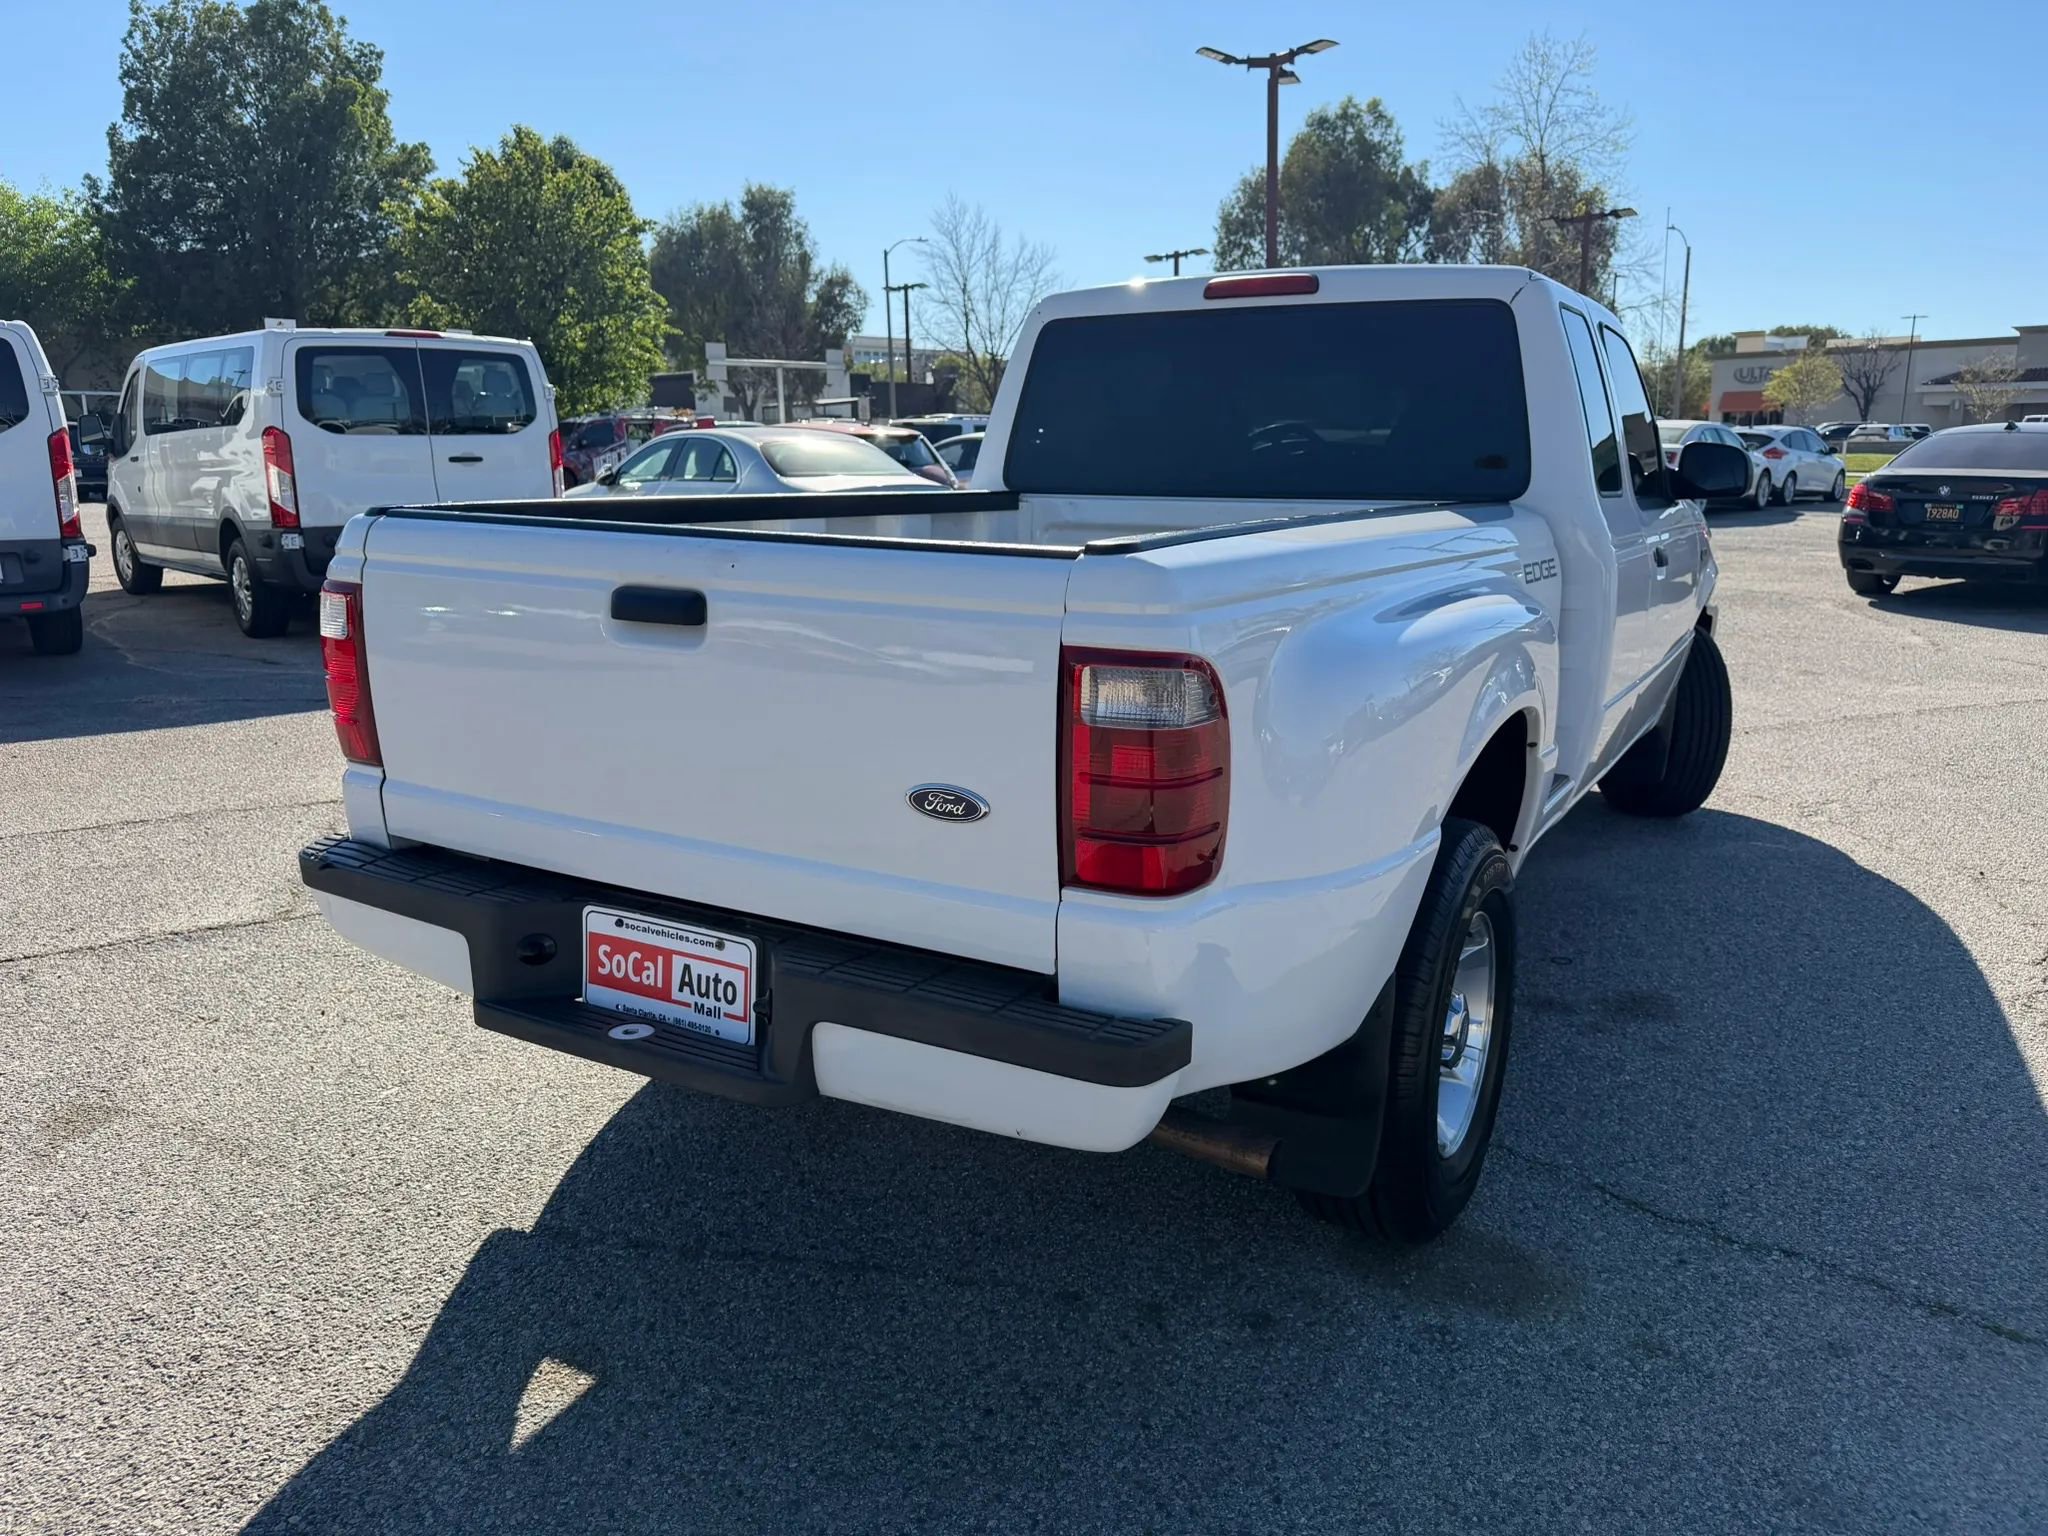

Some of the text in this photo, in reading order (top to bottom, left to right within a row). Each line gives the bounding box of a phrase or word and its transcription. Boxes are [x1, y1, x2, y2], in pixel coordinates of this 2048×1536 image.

[1523, 558, 1557, 584] EDGE
[924, 792, 966, 815] Ford
[624, 922, 715, 949] socalvehicles.com
[598, 944, 664, 988] SoCal
[678, 963, 737, 1006] Auto
[694, 1001, 721, 1020] Mall
